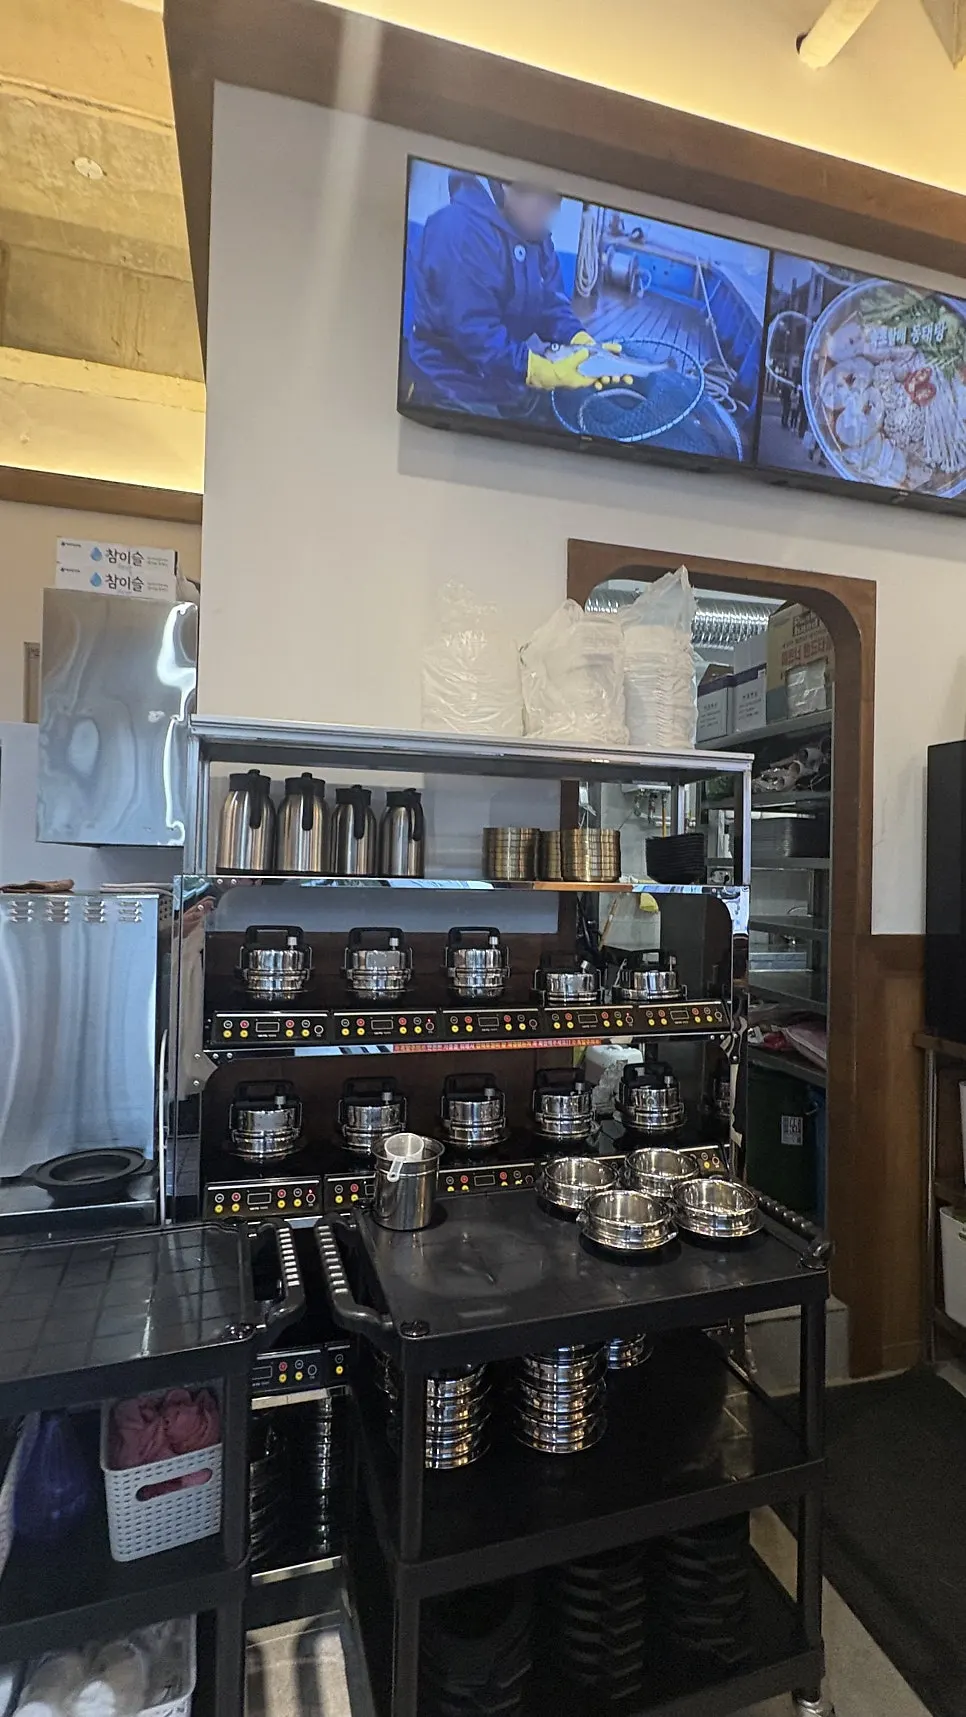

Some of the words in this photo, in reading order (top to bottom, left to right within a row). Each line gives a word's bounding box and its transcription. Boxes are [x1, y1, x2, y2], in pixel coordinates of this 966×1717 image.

[911, 320, 947, 344] 동태탕
[105, 548, 144, 567] 참이슬
[105, 574, 144, 592] 참이슬
